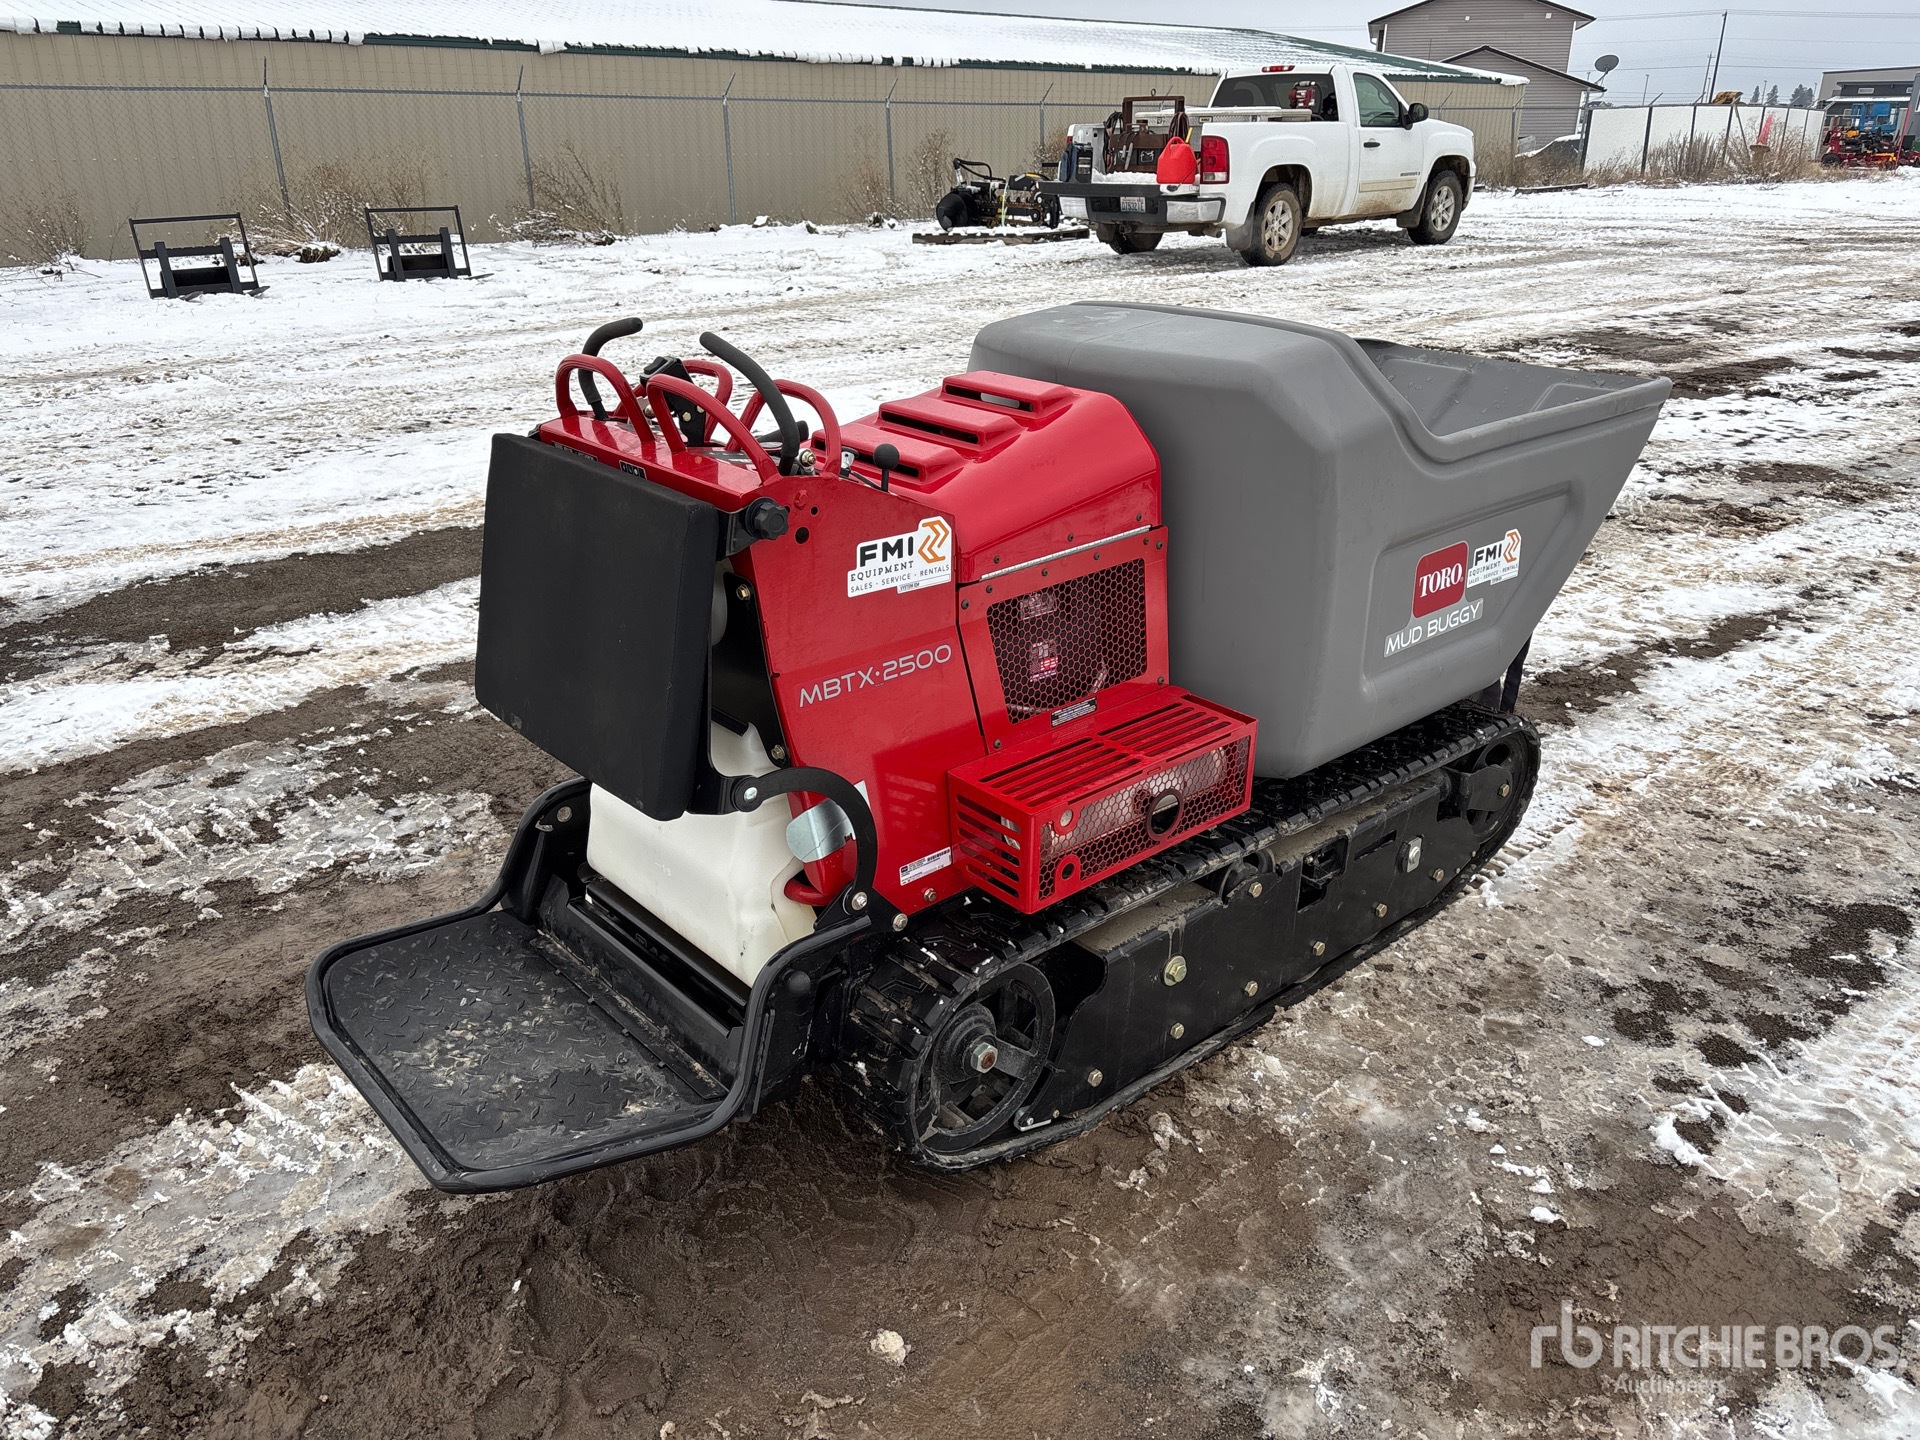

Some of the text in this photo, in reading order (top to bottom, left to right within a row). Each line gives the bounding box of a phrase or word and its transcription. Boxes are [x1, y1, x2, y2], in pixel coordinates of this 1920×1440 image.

[860, 536, 914, 567] FMI
[1475, 543, 1503, 566] FMI
[850, 561, 914, 582] EQUIPMENT
[850, 564, 950, 593] SALES SERVICE RENTALS
[1419, 563, 1463, 598] TORO
[1468, 561, 1501, 577] EQUIPMENT
[1385, 604, 1481, 655] MUD BUGGY
